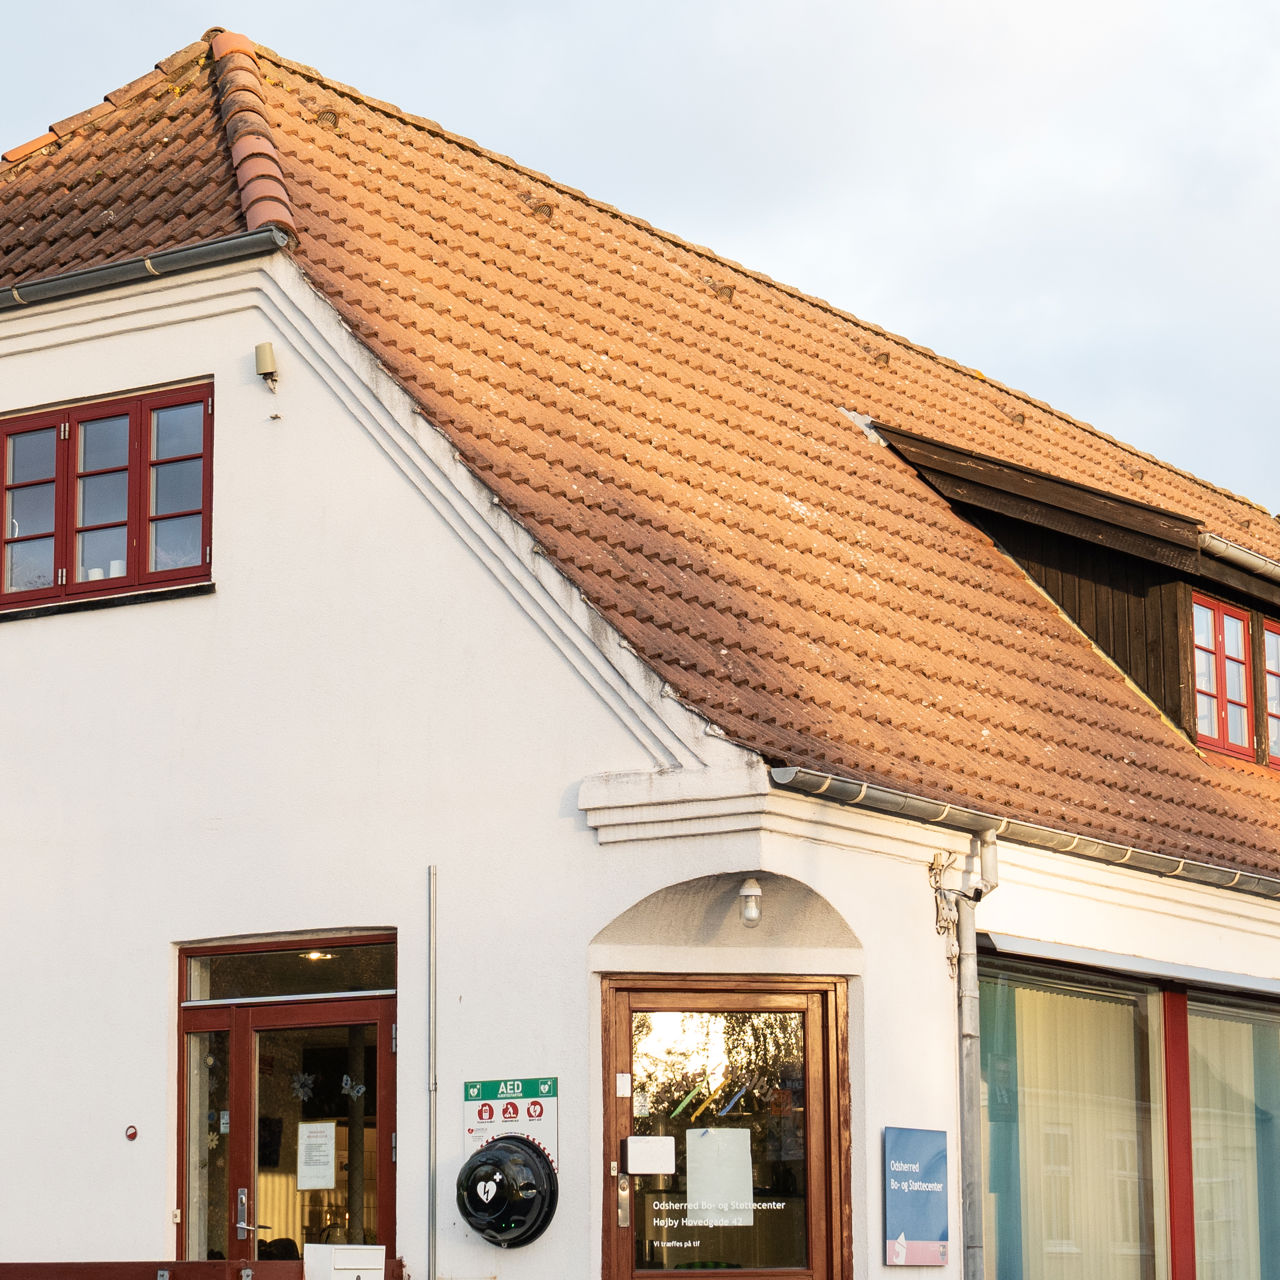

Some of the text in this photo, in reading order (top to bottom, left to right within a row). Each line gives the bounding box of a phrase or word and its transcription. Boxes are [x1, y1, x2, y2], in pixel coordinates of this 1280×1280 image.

[498, 1081, 523, 1094] AED
[890, 1160, 920, 1173] Odsherred
[890, 1178, 900, 1190] Bo-
[901, 1181, 909, 1193] og
[652, 1200, 699, 1210] Odsherred
[718, 1202, 729, 1212] og
[653, 1217, 679, 1228] Højby
[681, 1217, 730, 1228] Hovedgade
[684, 1239, 692, 1248] på
